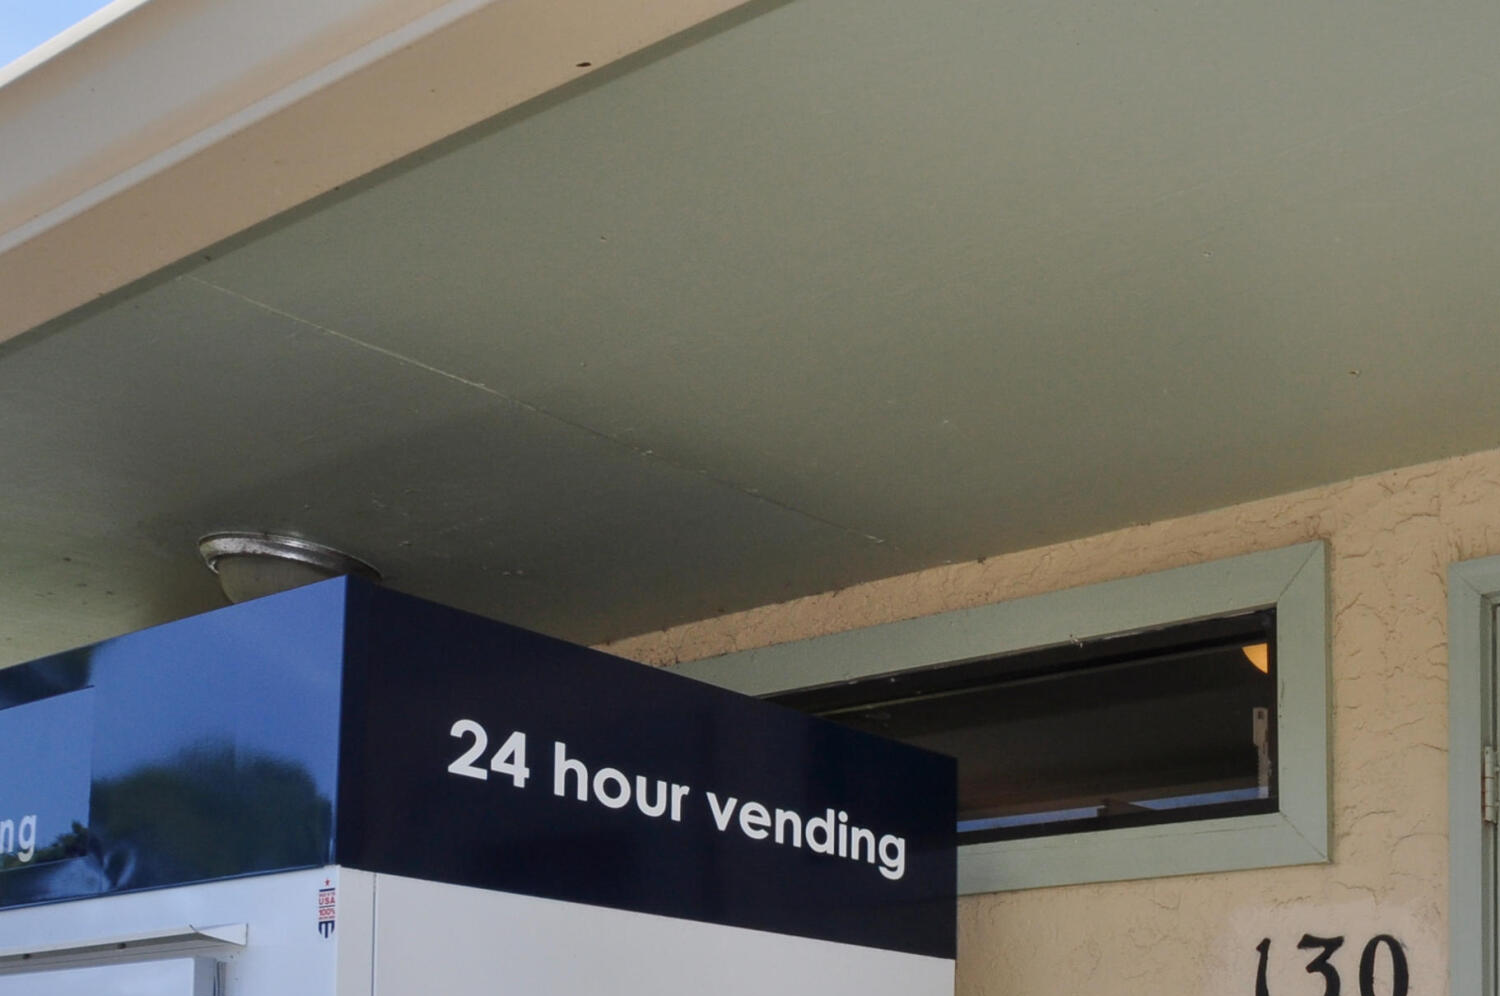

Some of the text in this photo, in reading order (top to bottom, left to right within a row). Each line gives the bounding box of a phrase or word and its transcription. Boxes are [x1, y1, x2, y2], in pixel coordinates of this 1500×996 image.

[447, 718, 906, 881] 24 hour vending
